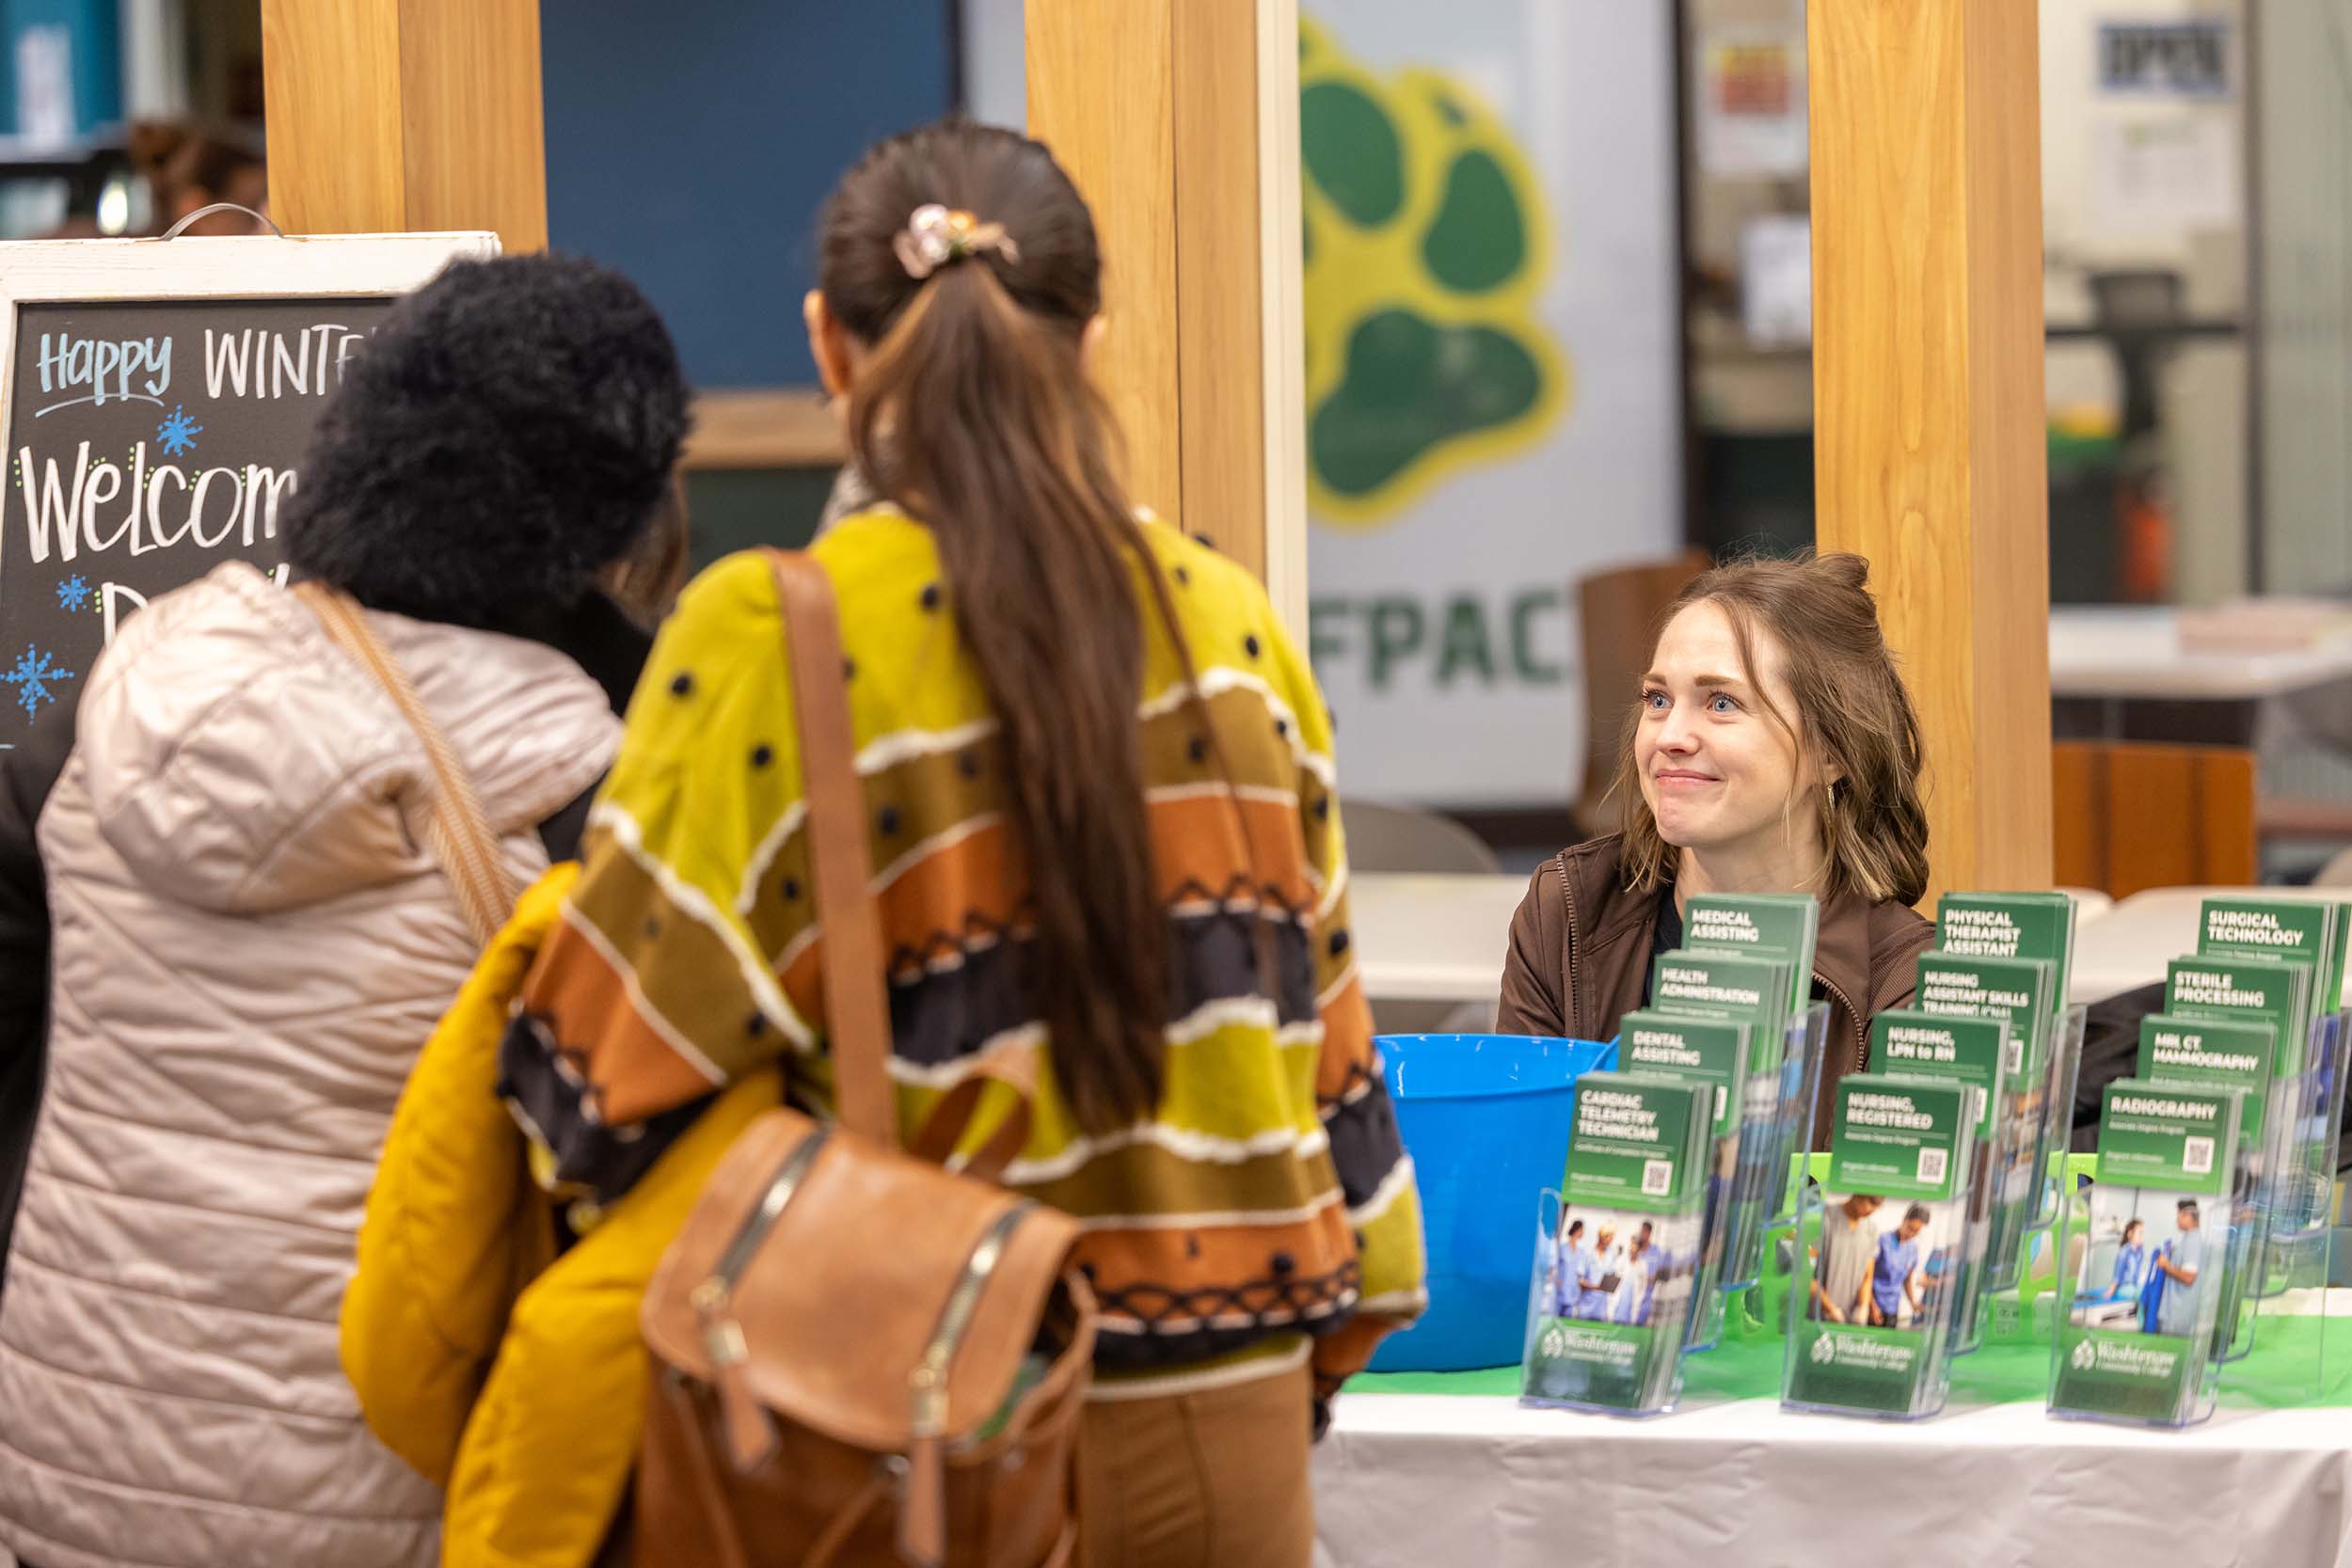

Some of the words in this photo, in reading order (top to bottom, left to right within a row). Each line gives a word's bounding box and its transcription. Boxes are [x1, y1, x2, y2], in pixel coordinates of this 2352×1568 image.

[36, 332, 173, 406] Happy
[1692, 909, 1752, 927] MEDICAL
[1945, 909, 2013, 927] PHYSICAL
[2208, 910, 2279, 929] SURGICAL
[1691, 923, 1759, 942] ASSISTING
[1945, 924, 2021, 942] THERAPIST
[2207, 925, 2303, 946] TECHNOLOGY
[1943, 940, 2018, 958] ASSISTANT
[1661, 967, 1708, 986] HEALTH
[1924, 971, 1979, 988] NURSING
[2175, 971, 2233, 990] STERILE
[1660, 982, 1760, 1006] ADMINISTRATION
[1923, 987, 1987, 1006] ASSISTANT
[1988, 990, 2029, 1007] SKILLS
[2174, 986, 2265, 1008] PROCESSING
[1923, 1001, 1978, 1017] TRAINING
[1632, 1031, 1686, 1050] DENTAL
[1887, 1026, 1955, 1047] NURSING,
[1631, 1046, 1701, 1066] ASSISTING
[1886, 1041, 1915, 1059] LPN
[1916, 1044, 1933, 1060] to
[1934, 1045, 1956, 1062] RN
[2153, 1048, 2259, 1071] MAMMOGRAPHY
[1581, 1089, 1643, 1111] CARDIAC
[1848, 1092, 1915, 1113] NURSING,
[2110, 1095, 2217, 1121] RADIOGRAPHY
[1580, 1104, 1657, 1126] TELEMETRY
[1846, 1107, 1933, 1130] REGISTERED
[1578, 1119, 1660, 1143] TECHNICIAN
